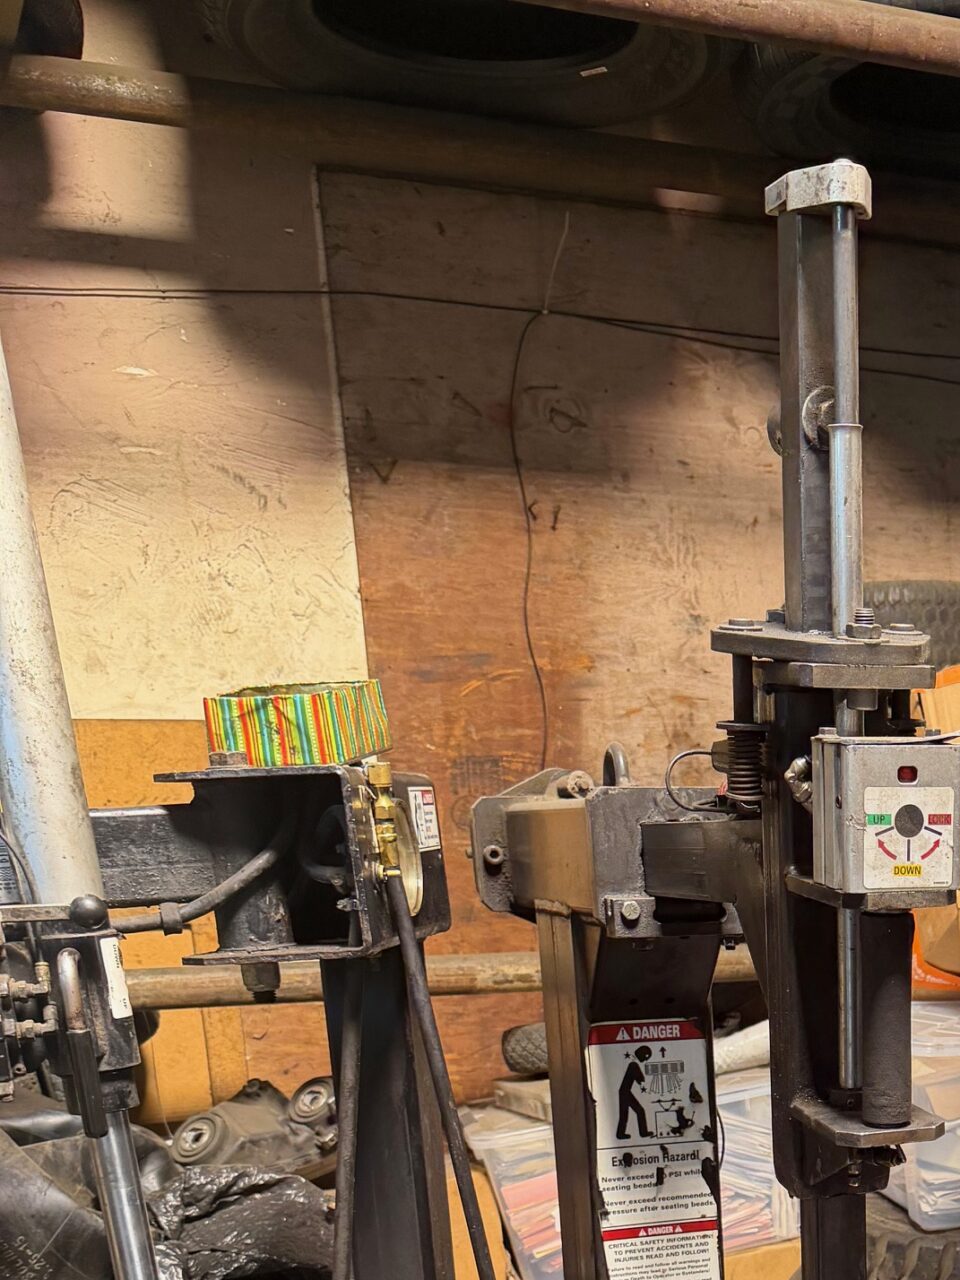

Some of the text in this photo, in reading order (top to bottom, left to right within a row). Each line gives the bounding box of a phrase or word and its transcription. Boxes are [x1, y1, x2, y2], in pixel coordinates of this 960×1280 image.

[873, 815, 886, 824] UP
[929, 814, 952, 825] LOCK
[893, 865, 922, 876] DOWN
[632, 1024, 681, 1040] DANGER
[611, 1149, 700, 1168] Exosion Hazard!
[626, 1173, 655, 1181] exceed
[668, 1170, 682, 1178] PSI
[684, 1168, 702, 1176] whil
[601, 1183, 631, 1192] seating
[628, 1197, 657, 1206] exceed
[657, 1192, 713, 1202] recommended
[604, 1200, 715, 1217] ressure after seating beads.
[647, 1225, 674, 1236] DANGER
[624, 1247, 653, 1255] PREVENT
[656, 1243, 692, 1251] ACCIDENTS
[614, 1255, 643, 1263] INJURIES
